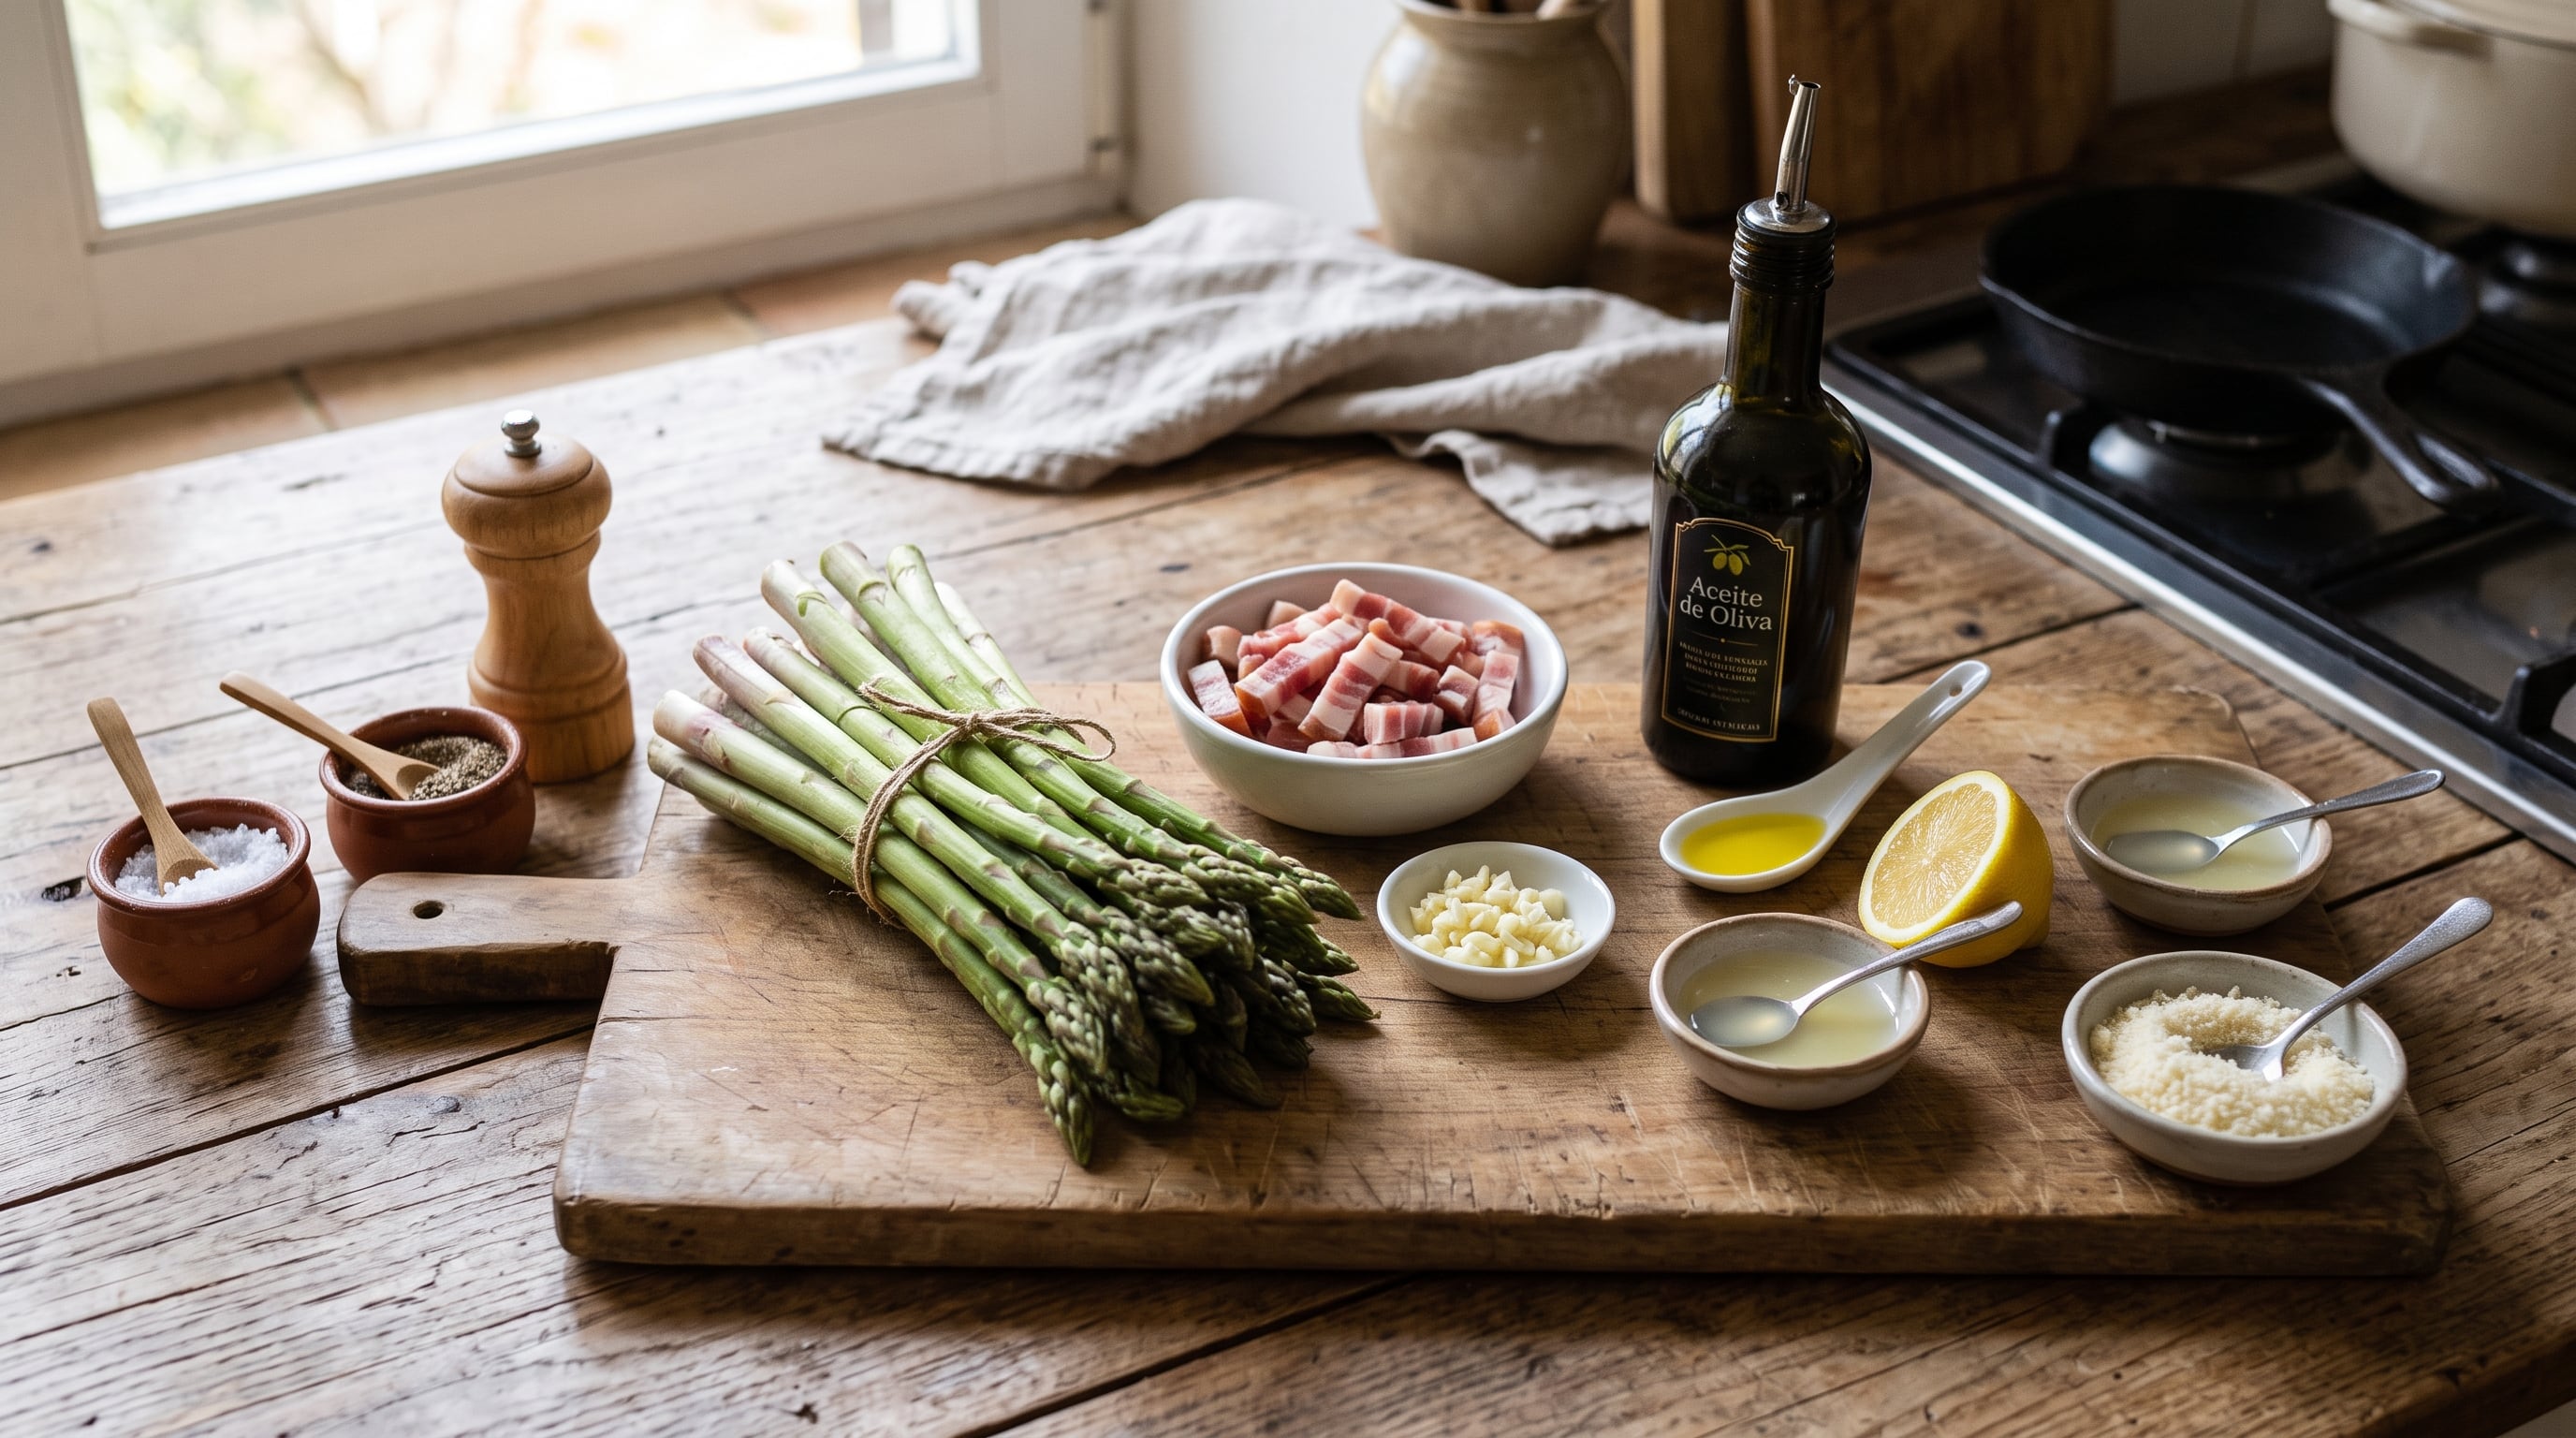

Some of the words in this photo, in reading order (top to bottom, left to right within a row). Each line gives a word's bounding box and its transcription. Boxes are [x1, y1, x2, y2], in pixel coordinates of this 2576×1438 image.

[1689, 576, 1763, 608] Aceite
[1679, 594, 1704, 619] de
[1710, 605, 1772, 630] Oliva
